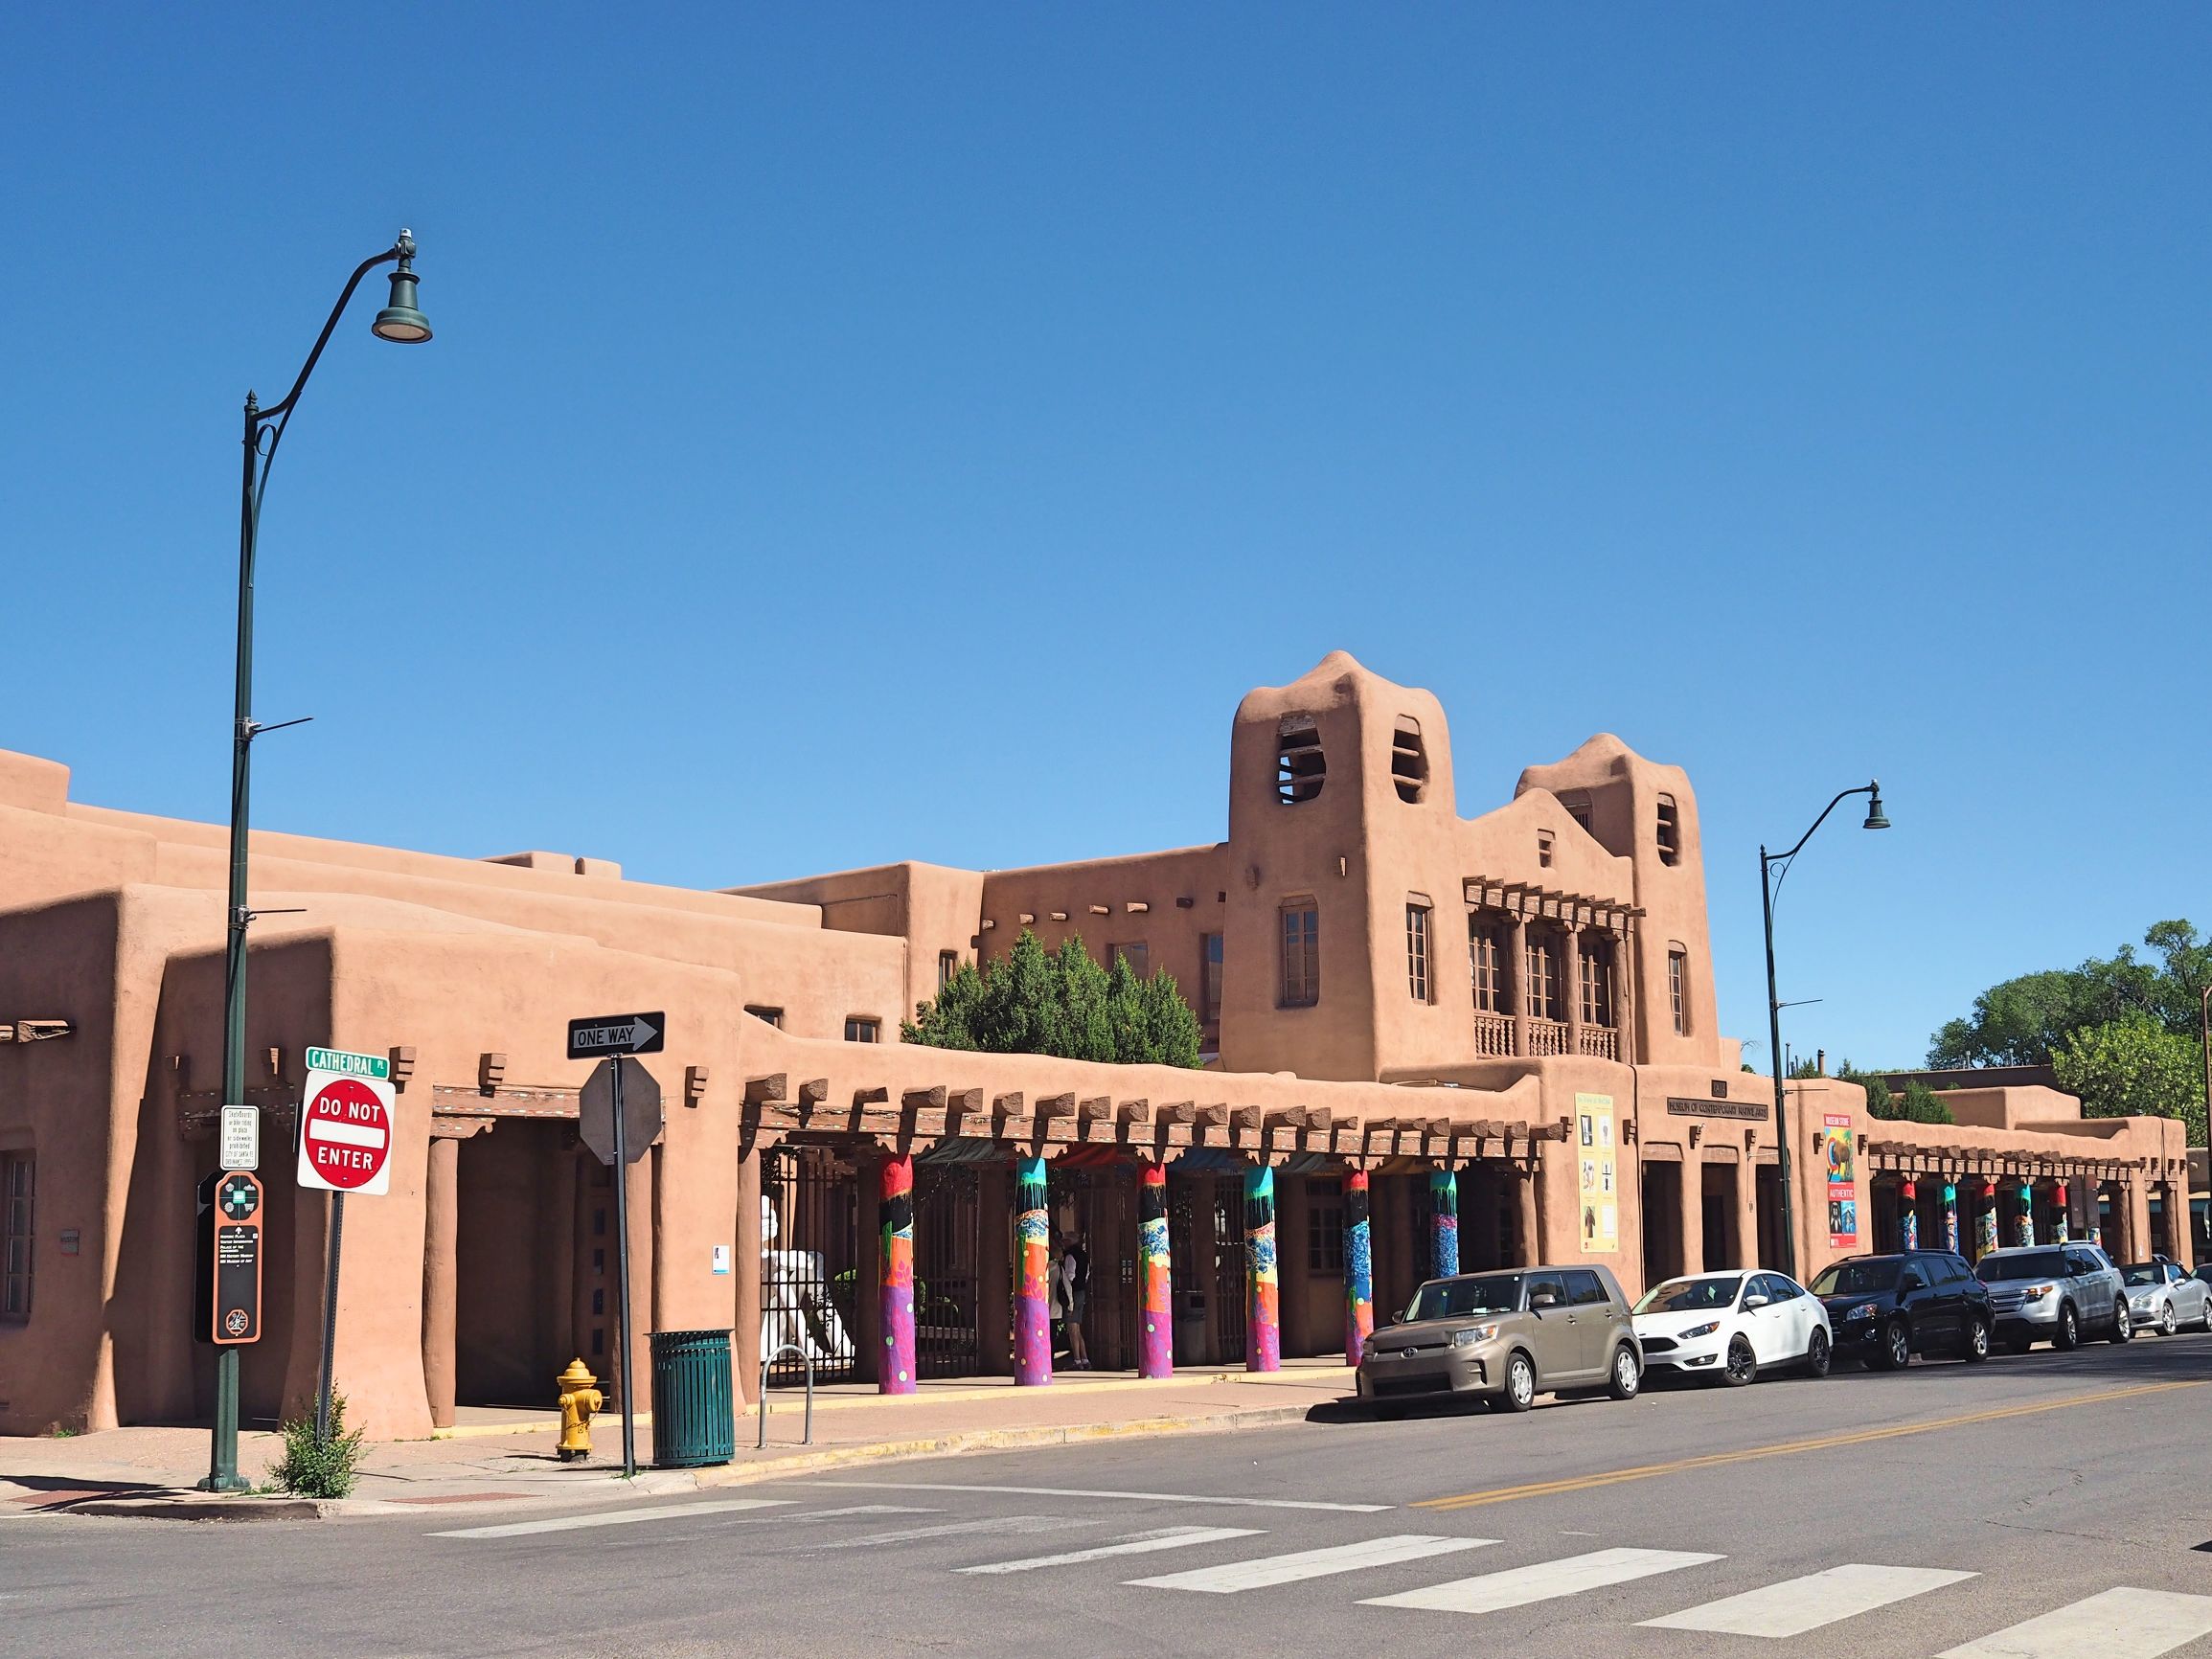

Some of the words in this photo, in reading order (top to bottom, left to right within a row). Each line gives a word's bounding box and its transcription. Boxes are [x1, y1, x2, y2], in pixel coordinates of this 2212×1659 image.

[579, 1030, 604, 1046] ONE
[608, 1026, 635, 1044] WAY
[311, 1050, 374, 1075] CATHEDRAL
[376, 1059, 384, 1070] PL
[319, 1096, 342, 1116] DO
[348, 1102, 380, 1123] NOT
[1669, 1101, 1690, 1112] MUSEUM
[1691, 1102, 1698, 1112] OF
[1738, 1106, 1754, 1117] NATIVE
[1755, 1107, 1767, 1119] ARTS
[317, 1146, 374, 1170] ENTER
[1830, 1188, 1854, 1198] AUTHENTIC
